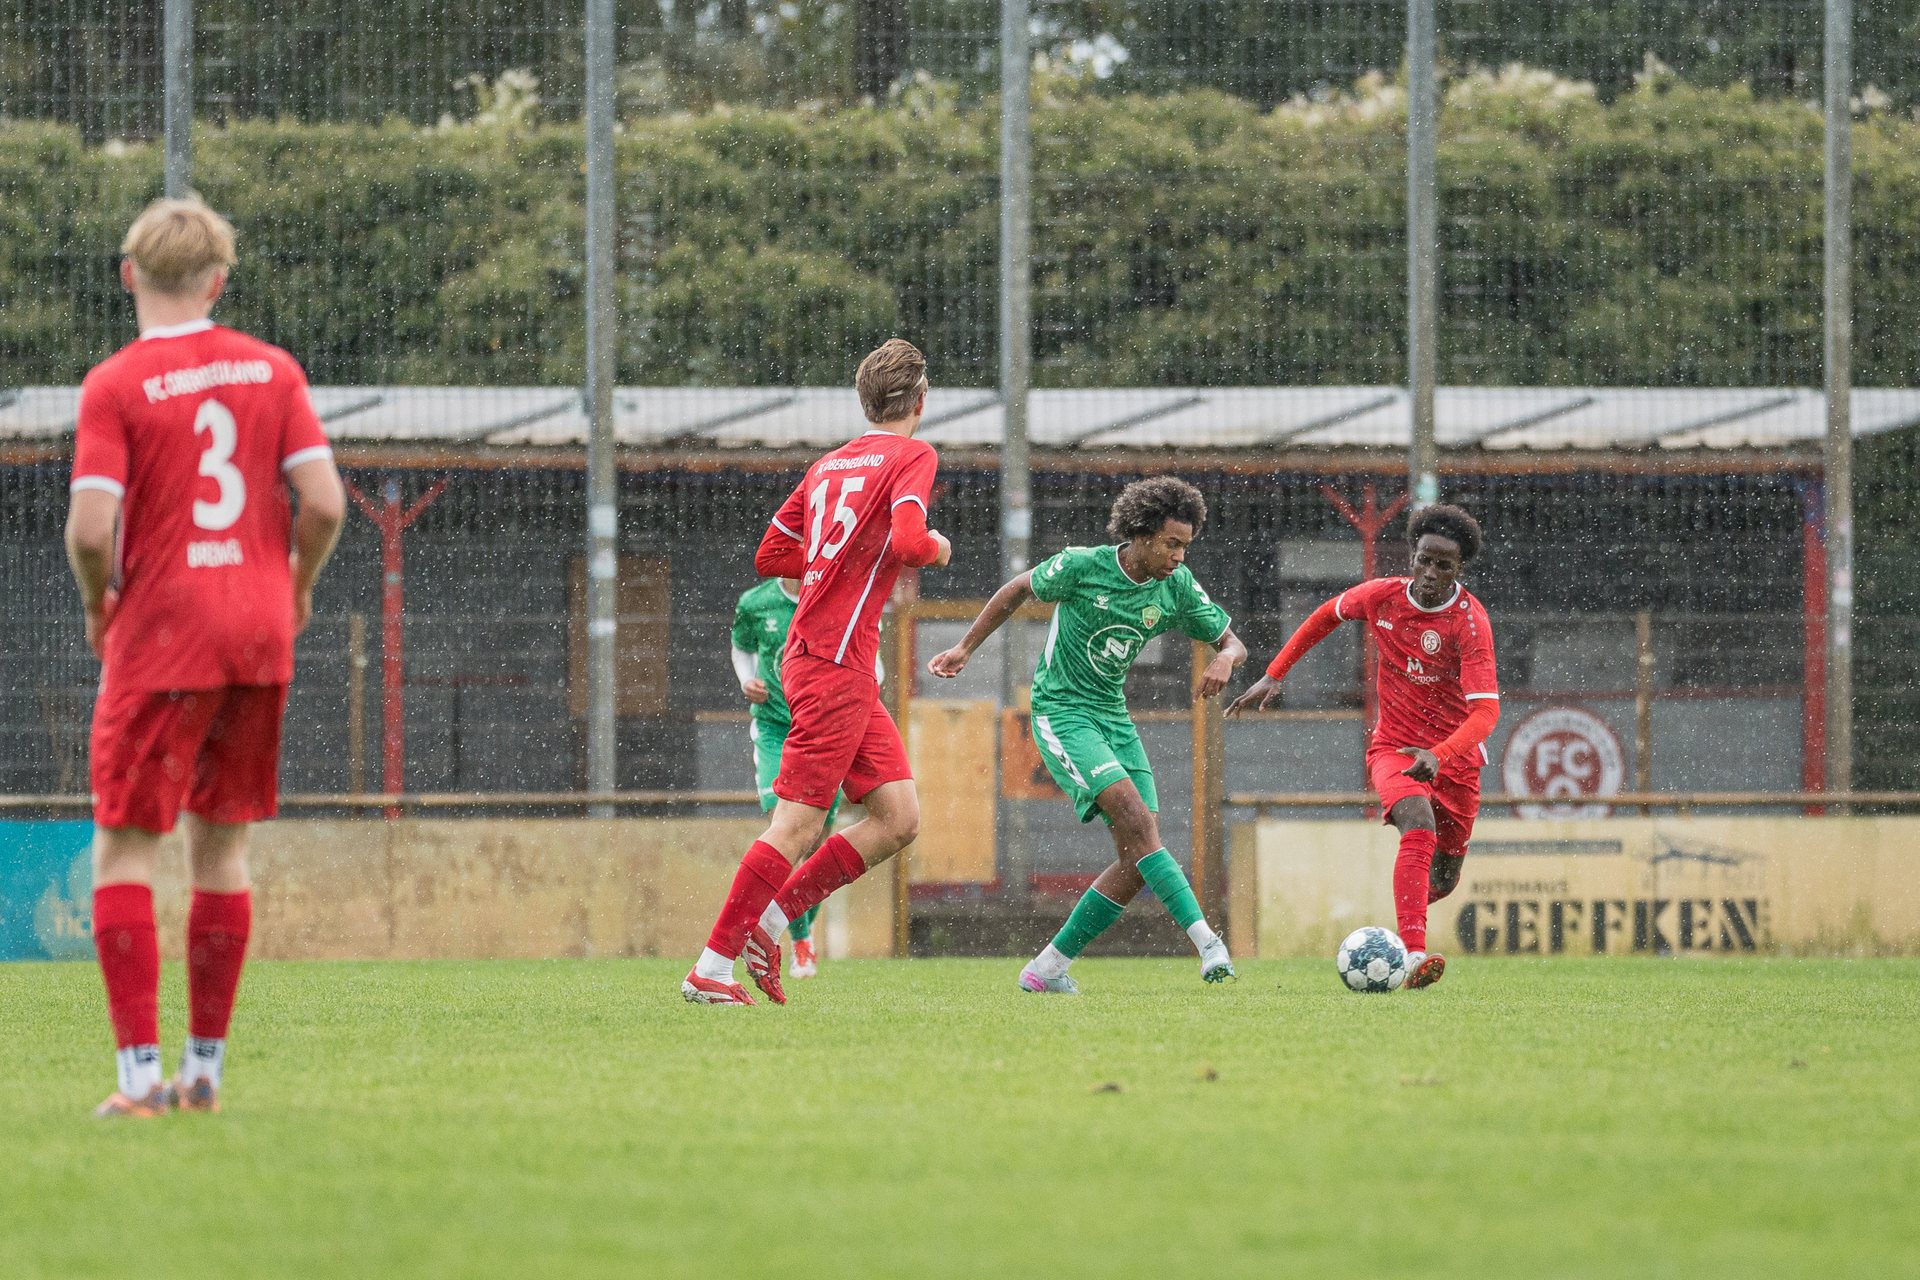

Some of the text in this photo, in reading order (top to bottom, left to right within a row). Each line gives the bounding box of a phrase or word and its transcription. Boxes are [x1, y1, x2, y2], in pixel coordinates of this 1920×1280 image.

[193, 398, 246, 531] 3
[808, 477, 865, 563] 15
[1376, 619, 1393, 630] JAKO
[1537, 740, 1592, 778] FC
[1456, 899, 1759, 954] GEFFKEN
